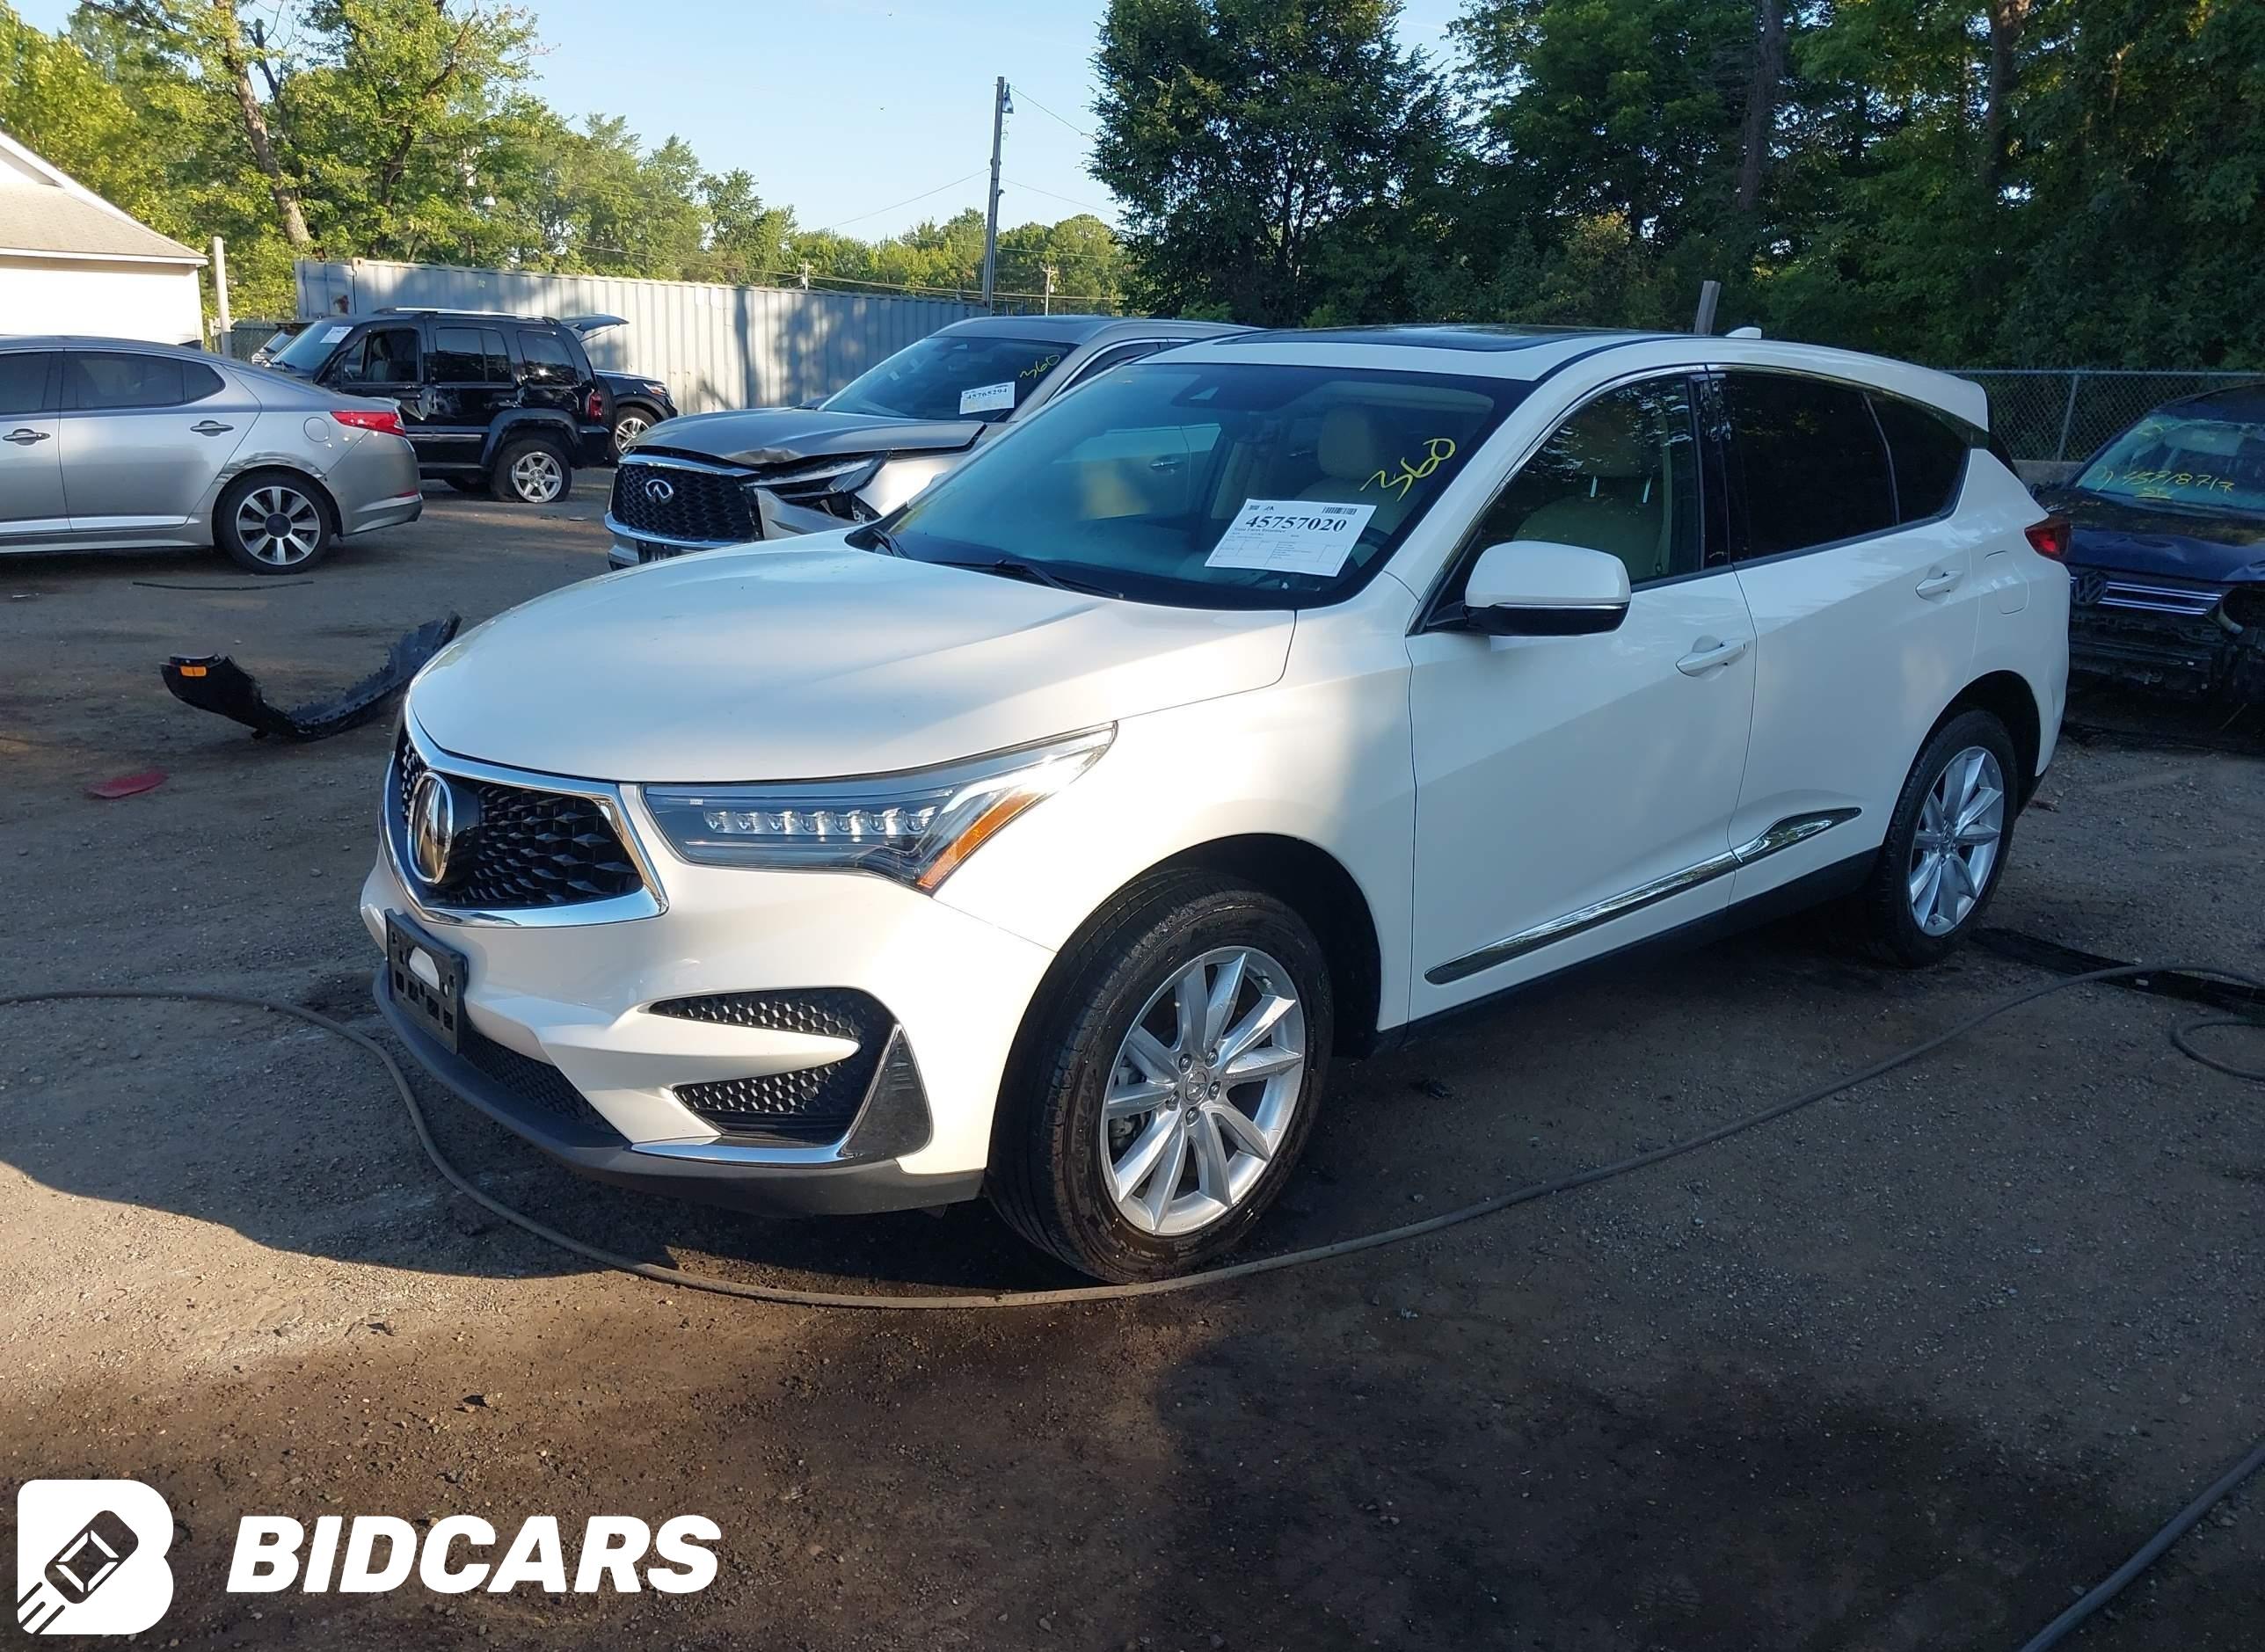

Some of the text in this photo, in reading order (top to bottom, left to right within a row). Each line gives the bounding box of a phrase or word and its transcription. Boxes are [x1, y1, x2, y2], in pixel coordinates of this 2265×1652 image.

[1019, 354, 1060, 379] 360
[1359, 438, 1456, 502] 360
[1245, 515, 1347, 533] 45757020
